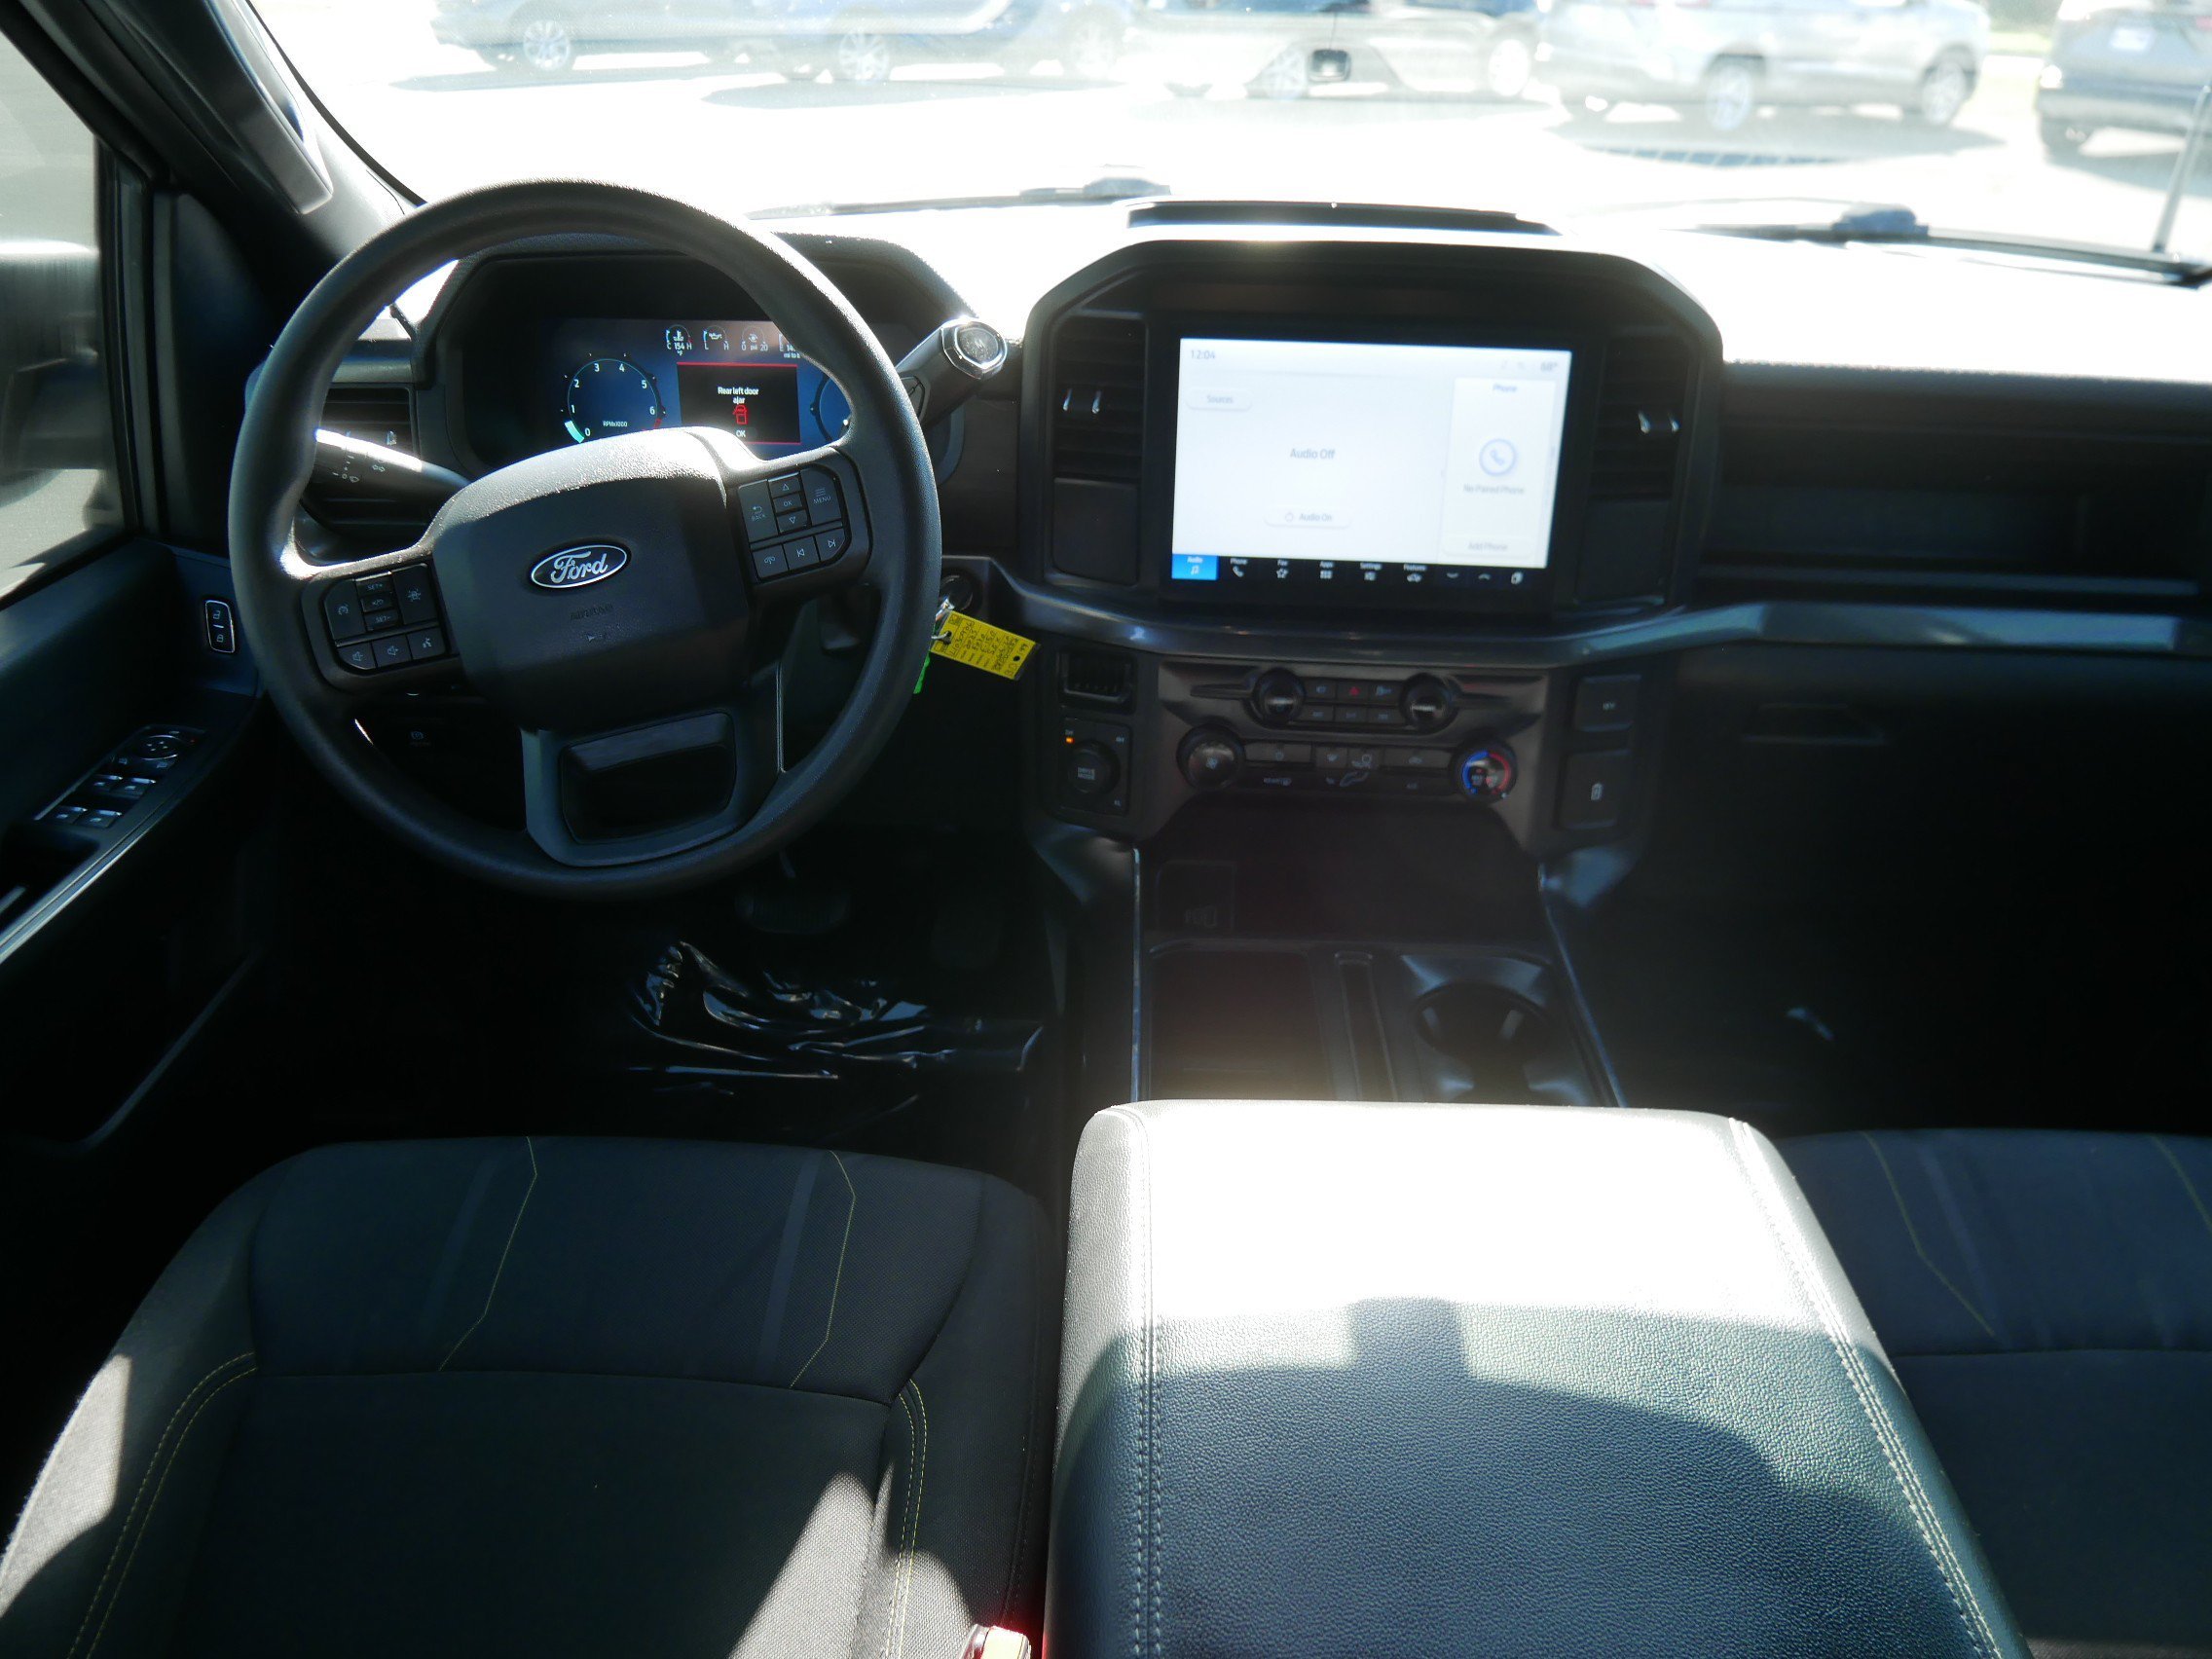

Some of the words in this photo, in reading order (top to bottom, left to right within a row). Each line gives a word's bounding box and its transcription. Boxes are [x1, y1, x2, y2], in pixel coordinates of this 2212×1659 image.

[704, 342, 710, 350] L
[723, 342, 729, 350] H
[1190, 350, 1216, 360] 12:04
[594, 363, 600, 372] 3
[618, 363, 625, 372] 4
[573, 379, 580, 387] 2
[641, 380, 647, 388] 5
[718, 387, 732, 395] Rear
[732, 387, 744, 395] left
[744, 387, 759, 395] door
[1206, 394, 1235, 404] Sources
[571, 404, 575, 414] 1
[649, 406, 655, 416] 6
[584, 427, 591, 437] 0
[1290, 448, 1318, 460] Audio
[1319, 448, 1337, 460] Off
[813, 496, 831, 505] MENU
[1299, 512, 1321, 522] Audio
[1321, 513, 1333, 522] On
[550, 551, 608, 584] Ford
